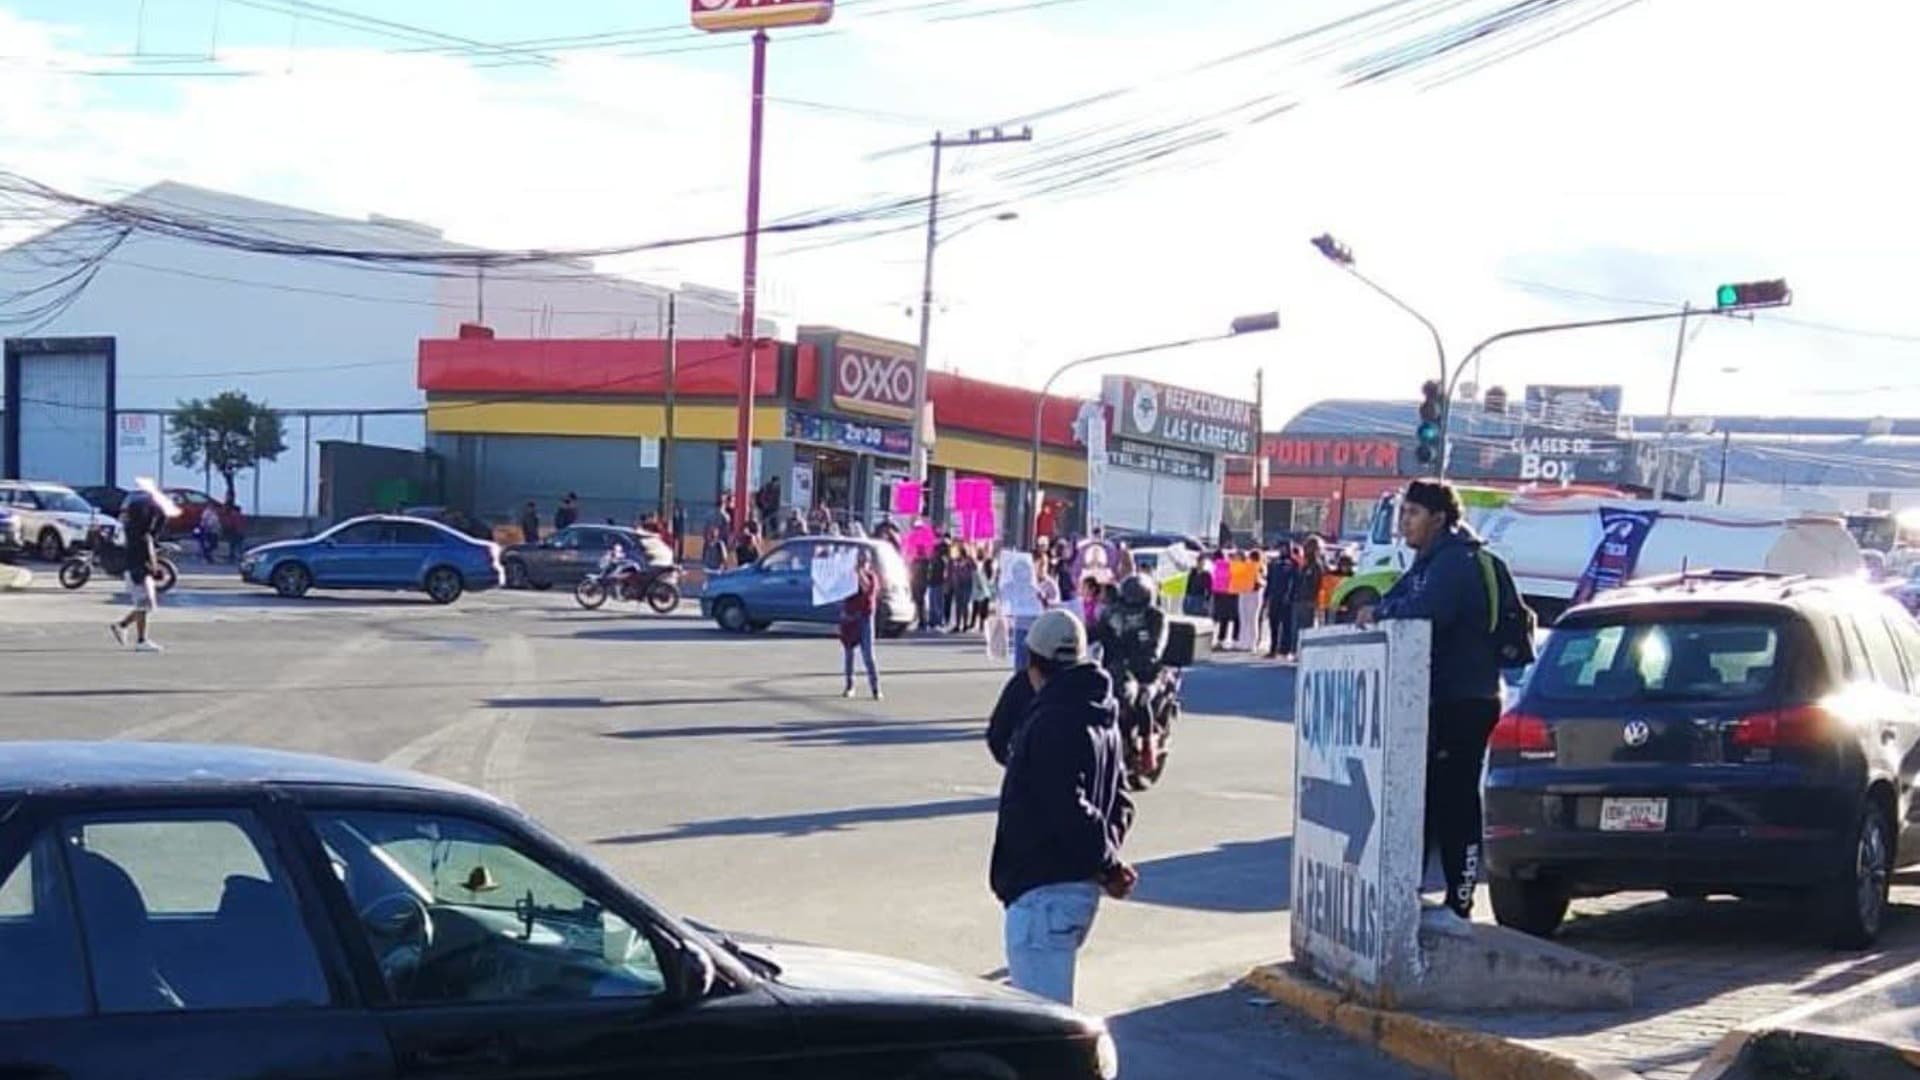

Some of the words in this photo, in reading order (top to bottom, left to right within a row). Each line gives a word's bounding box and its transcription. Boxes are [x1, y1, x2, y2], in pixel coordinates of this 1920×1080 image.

[840, 354, 913, 401] OXXO
[1163, 416, 1188, 442] LAS
[1190, 422, 1249, 453] CARRETAS
[1511, 437, 1570, 453] CLASES
[1302, 669, 1366, 750] CAMINO
[1369, 669, 1381, 749] A
